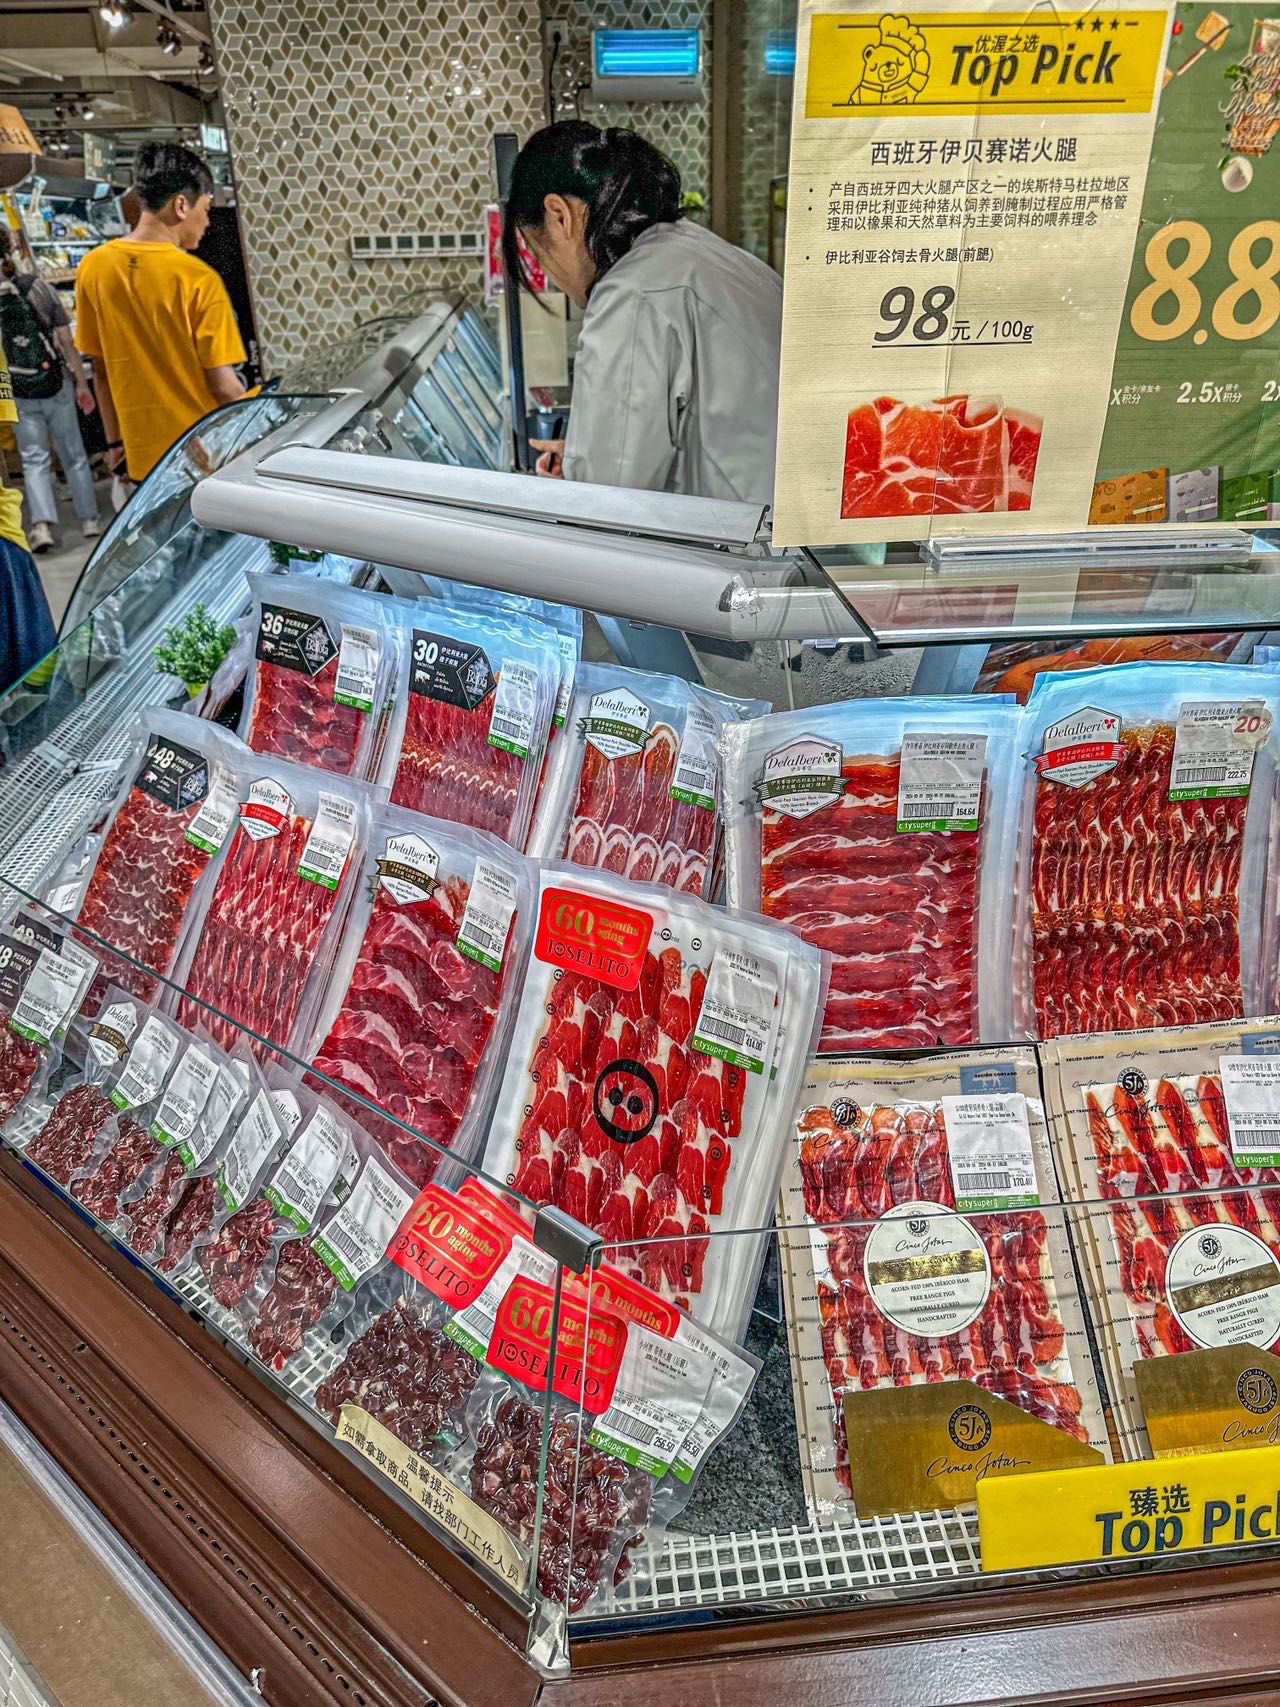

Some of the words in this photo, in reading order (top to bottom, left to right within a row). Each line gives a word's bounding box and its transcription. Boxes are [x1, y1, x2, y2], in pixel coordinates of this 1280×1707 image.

[974, 33, 1040, 54] 优渥之选
[950, 45, 1020, 97] Top
[1031, 41, 1122, 85] Pick
[871, 137, 1077, 166] 西班牙伊贝赛诺火腿
[829, 176, 1130, 197] 产自西班牙四大火腿产区之一的埃斯特马杜拉地区
[828, 195, 1127, 215] 采用伊比利亚纯种猪从饲养到腌制过程应用严格管
[827, 211, 1098, 232] 理和以橡果和天然草料为主要饲料的喂养理念
[1121, 393, 1141, 405] 积分
[1223, 393, 1242, 403] 积分
[261, 611, 285, 635] 36
[413, 639, 439, 664] 30
[593, 696, 638, 717] Delalberi
[1048, 719, 1103, 739] Delalberi
[153, 747, 176, 769] 48
[767, 752, 823, 770] Delalberi
[1227, 771, 1247, 779] 222.75
[955, 807, 976, 816] 164.64
[388, 839, 427, 862] Delalberi
[555, 903, 595, 936] 60
[599, 917, 640, 937] months
[597, 928, 625, 947] aging
[547, 939, 629, 978] JOSELITO
[1125, 1074, 1138, 1093] 5J
[413, 1200, 455, 1240] 60
[455, 1224, 496, 1258] months
[447, 1235, 478, 1265] aging
[1203, 1240, 1214, 1254] 5J
[396, 1234, 471, 1297] OSELITO
[910, 1294, 923, 1302] FREE
[923, 1292, 942, 1300] RANGE
[943, 1290, 956, 1298] PIGS
[1257, 1292, 1269, 1301] HAM
[511, 1295, 553, 1341] 60
[615, 1296, 663, 1331] months
[909, 1304, 942, 1313] NATURALLY
[917, 1312, 957, 1323] HANDCRAFTED
[1216, 1316, 1229, 1324] FREE
[1229, 1311, 1246, 1321] RANGE
[1247, 1308, 1259, 1316] PIGS
[1218, 1323, 1247, 1336] NATURALLY
[1247, 1317, 1265, 1327] CURED
[1227, 1329, 1264, 1344] HANDCRAFTED
[1246, 1379, 1261, 1405] 5J
[959, 1416, 977, 1441] 5J
[1222, 1420, 1265, 1443] Cinco
[653, 1435, 675, 1453] 256.50
[926, 1456, 973, 1478] Cinco
[975, 1451, 1031, 1481] Jotas
[406, 1453, 455, 1505] 温馨提示
[1129, 1483, 1191, 1517] 臻选
[1095, 1511, 1184, 1556] Top
[1203, 1490, 1280, 1544] Pic
